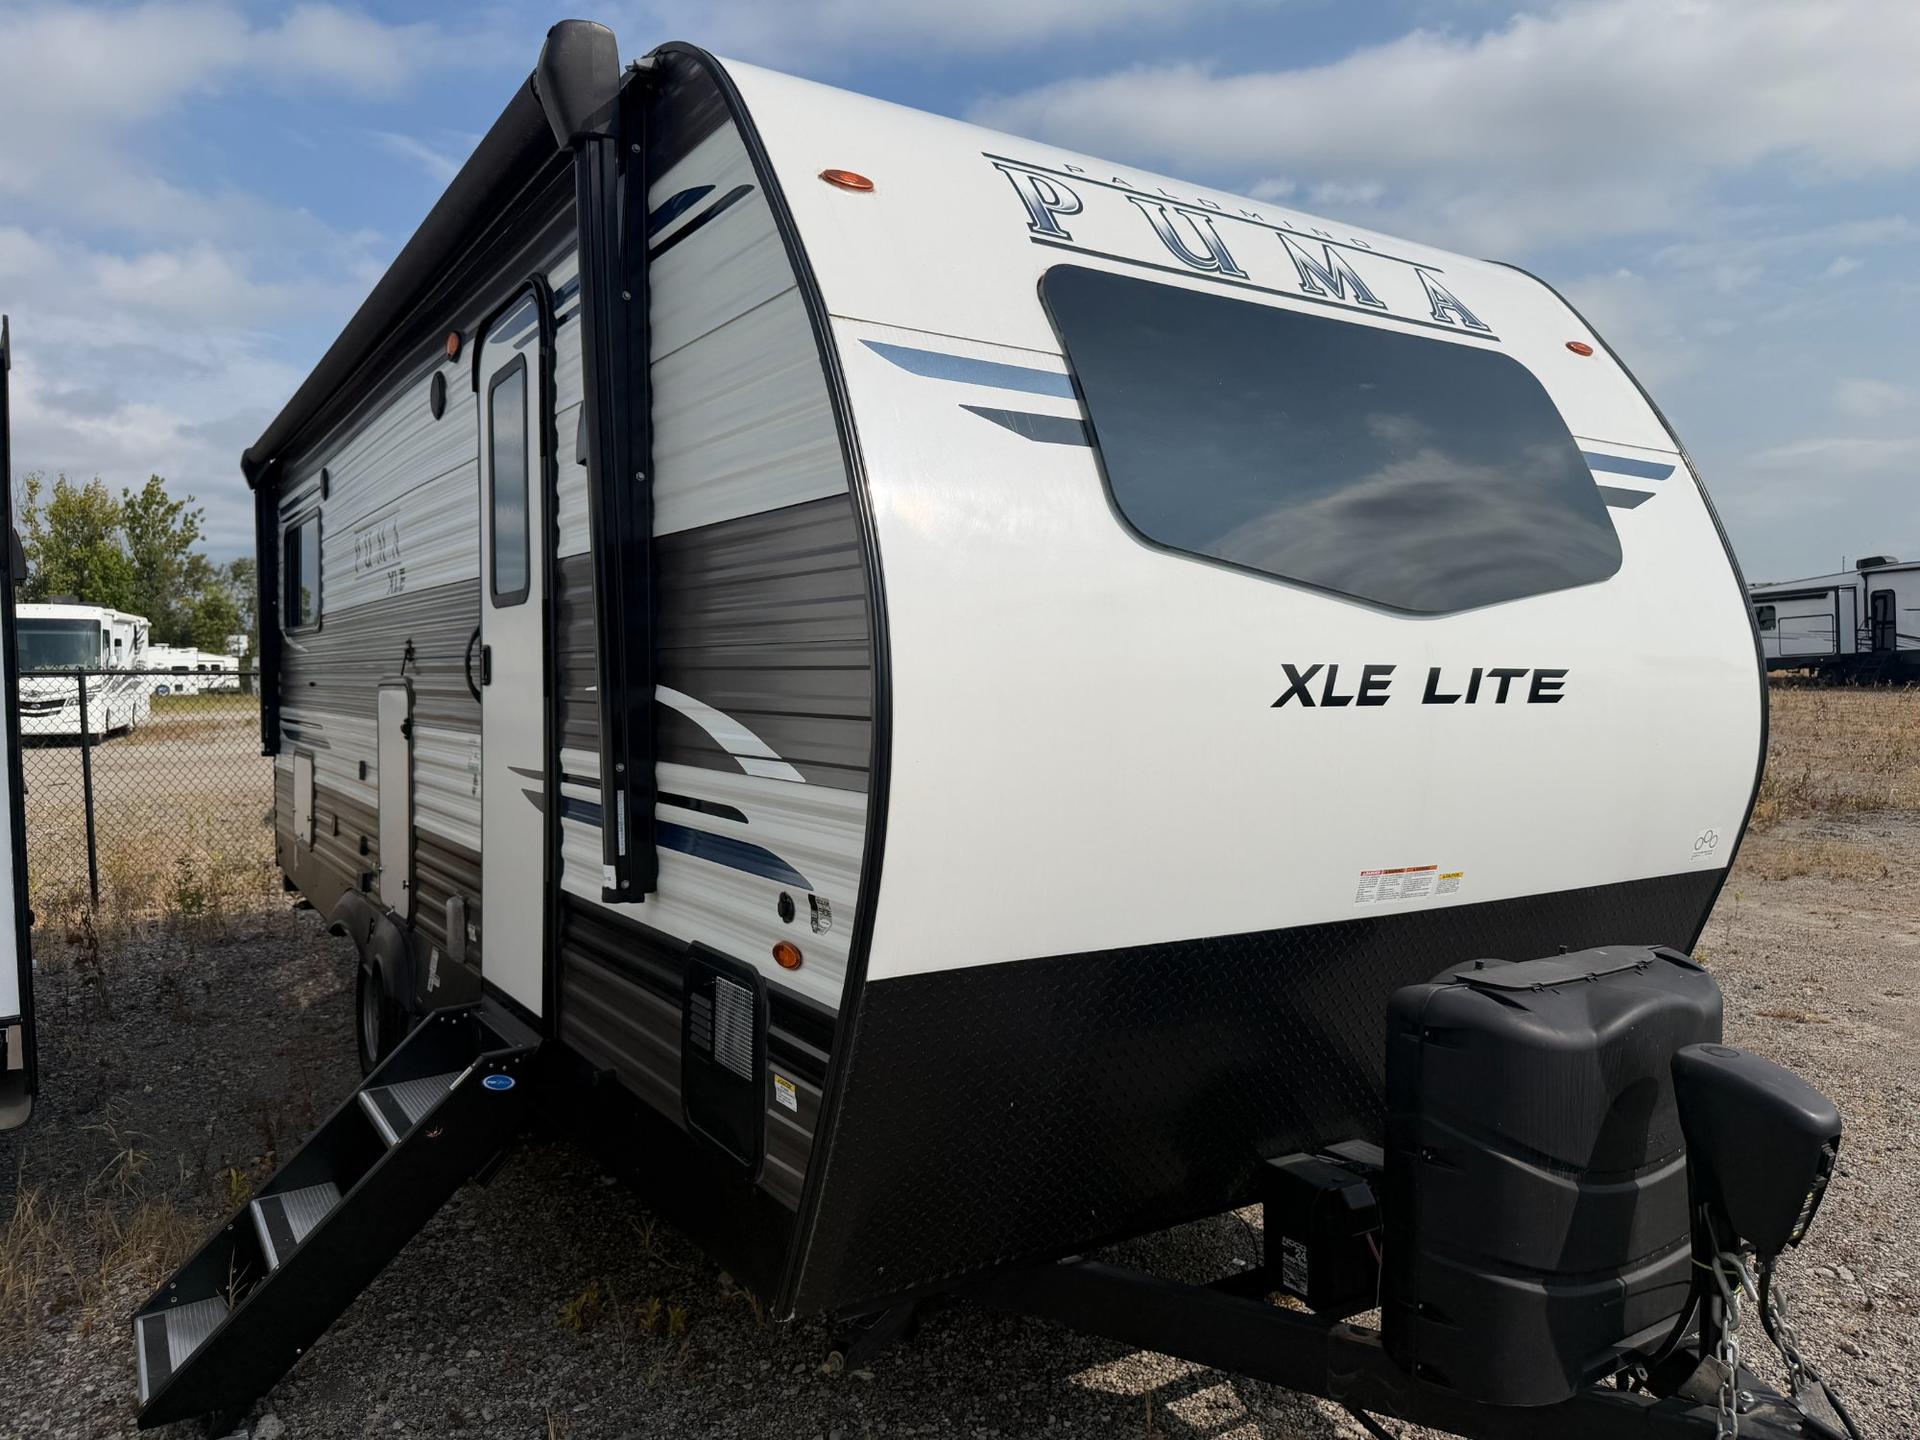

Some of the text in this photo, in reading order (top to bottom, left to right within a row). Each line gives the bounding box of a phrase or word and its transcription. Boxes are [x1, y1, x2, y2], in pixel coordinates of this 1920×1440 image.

[1065, 163, 1371, 249] PALOMINO
[993, 161, 1492, 333] PUMA
[353, 519, 401, 573] PUMA
[1270, 663, 1570, 708] XLE LITE
